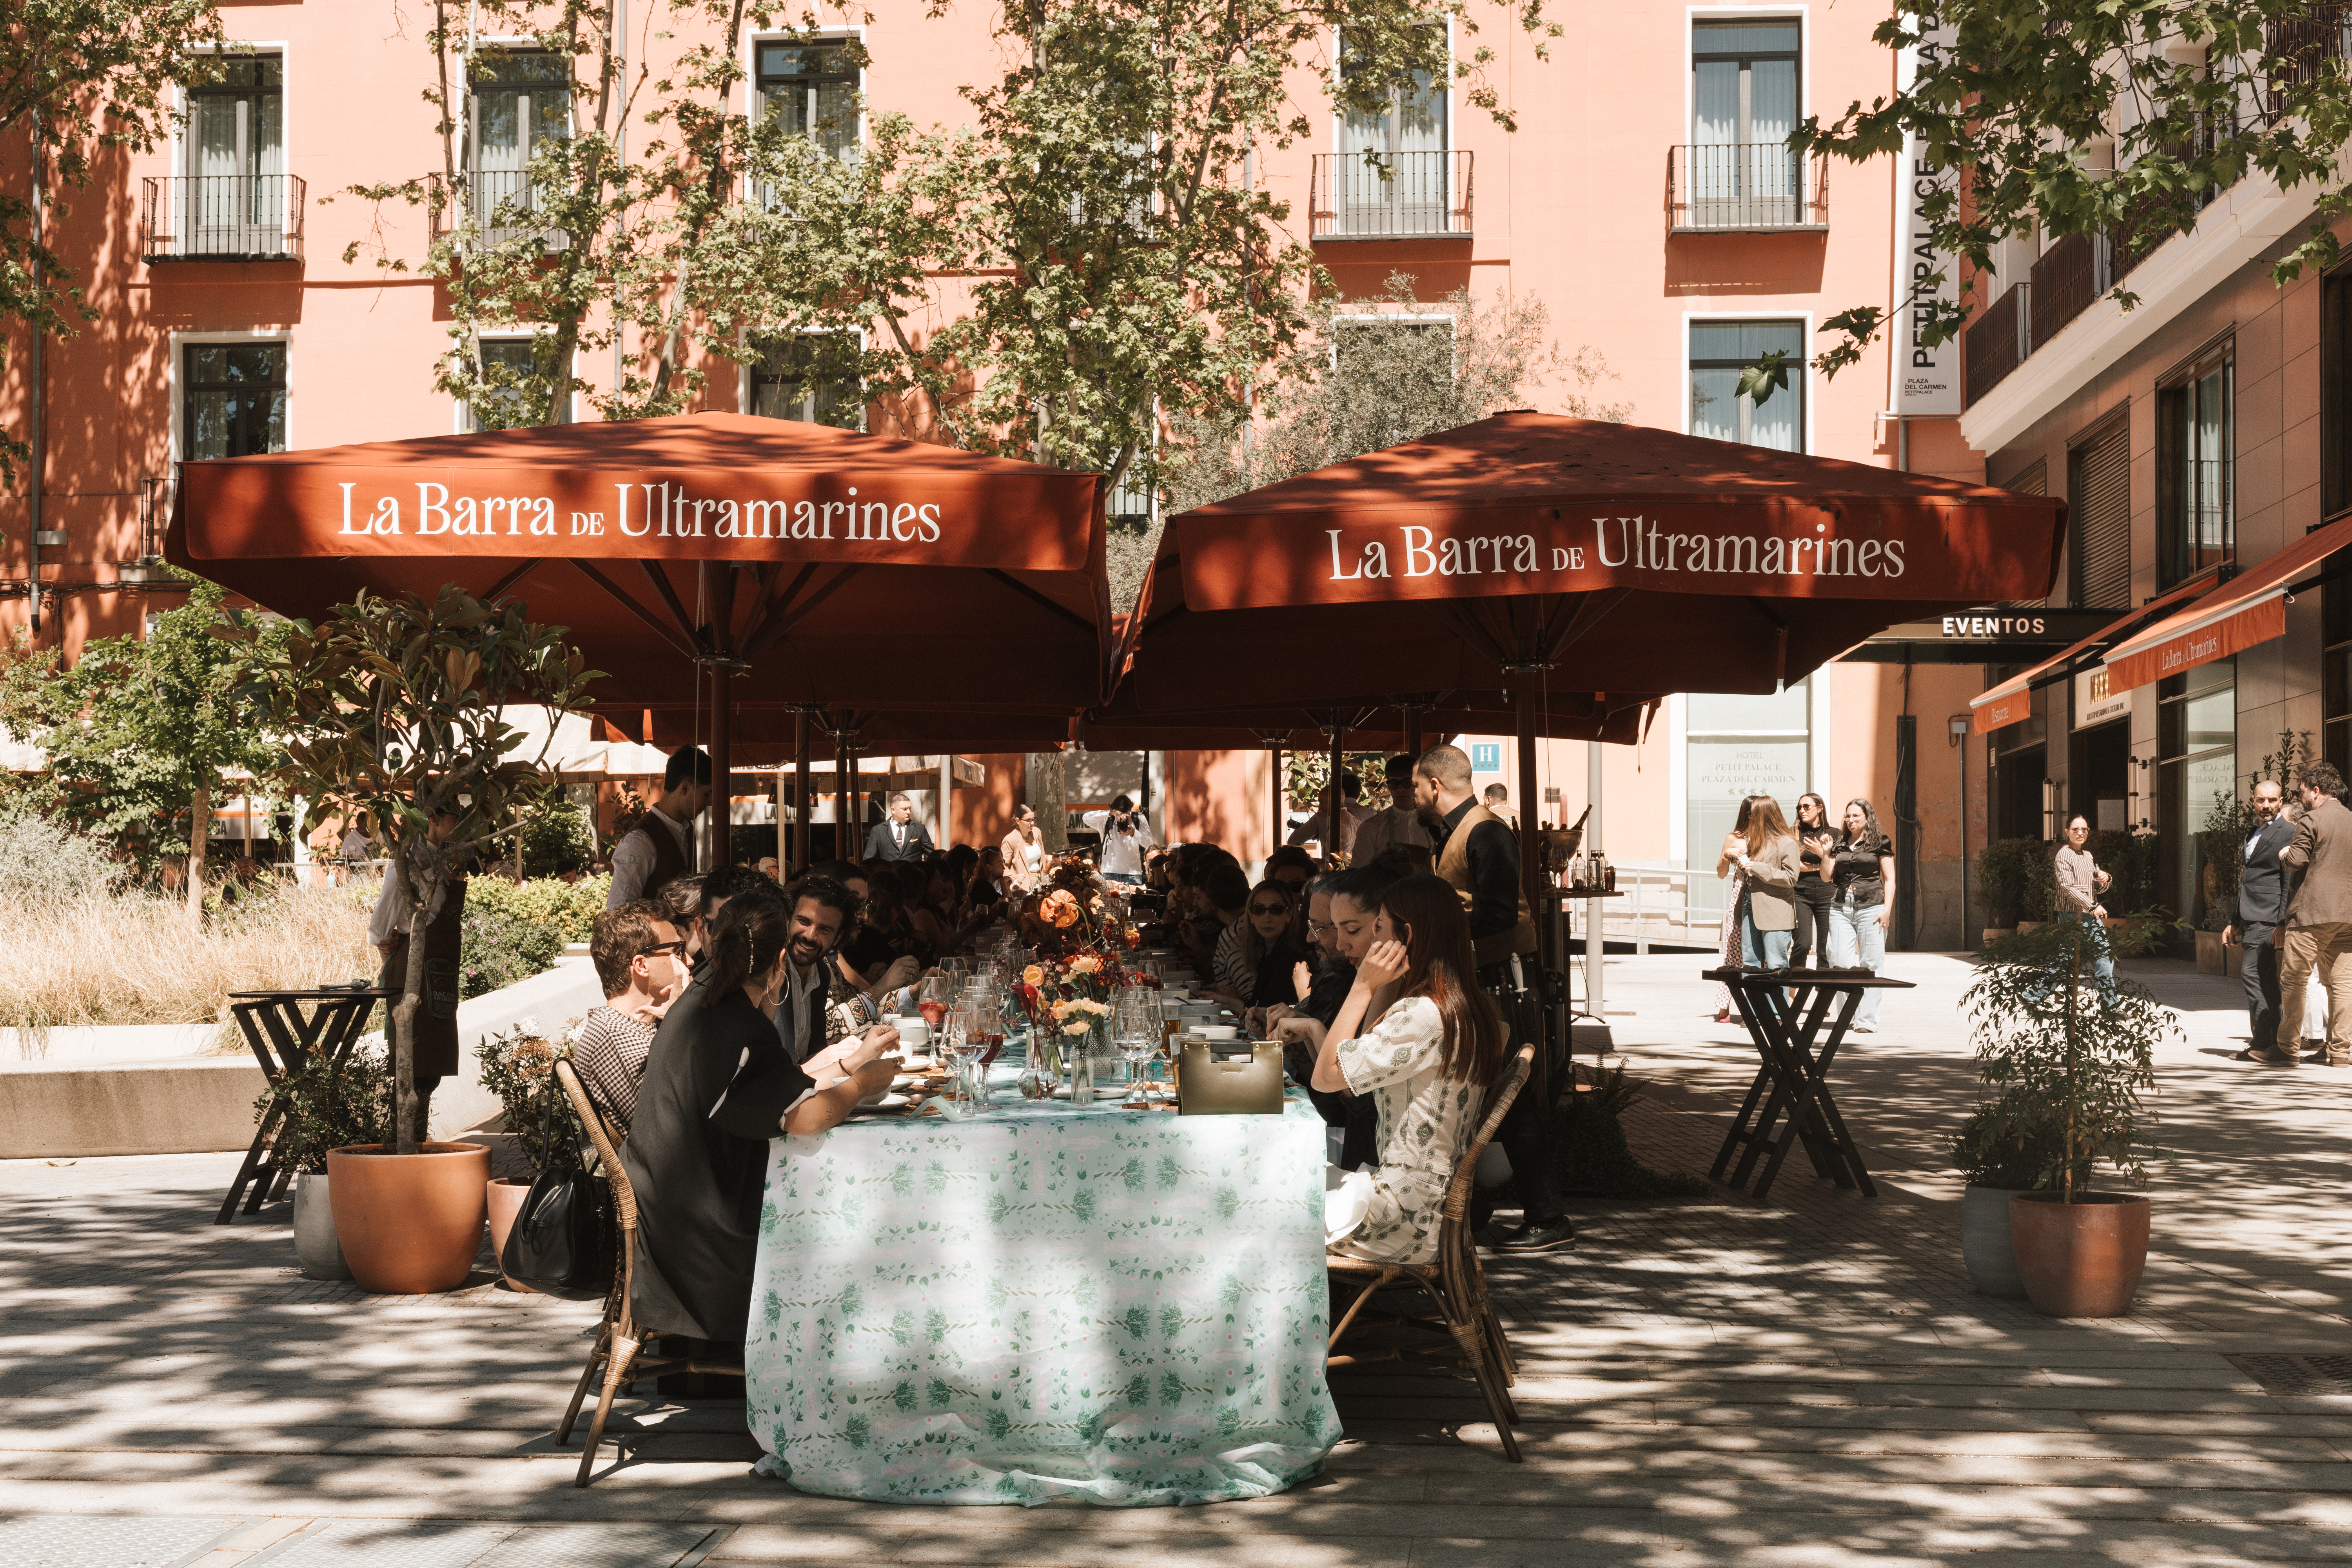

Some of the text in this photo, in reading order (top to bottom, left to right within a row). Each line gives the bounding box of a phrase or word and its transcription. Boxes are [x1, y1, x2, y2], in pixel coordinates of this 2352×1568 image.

[338, 481, 941, 543] La Barra DE Ultramarines
[1325, 515, 1905, 580] La Barra DE Ultramarines
[1943, 617, 2044, 633] EVENTOS
[2163, 652, 2169, 670] La
[2169, 650, 2182, 668] Barra
[2186, 635, 2217, 661] Ultramarines
[1479, 746, 1493, 762] H
